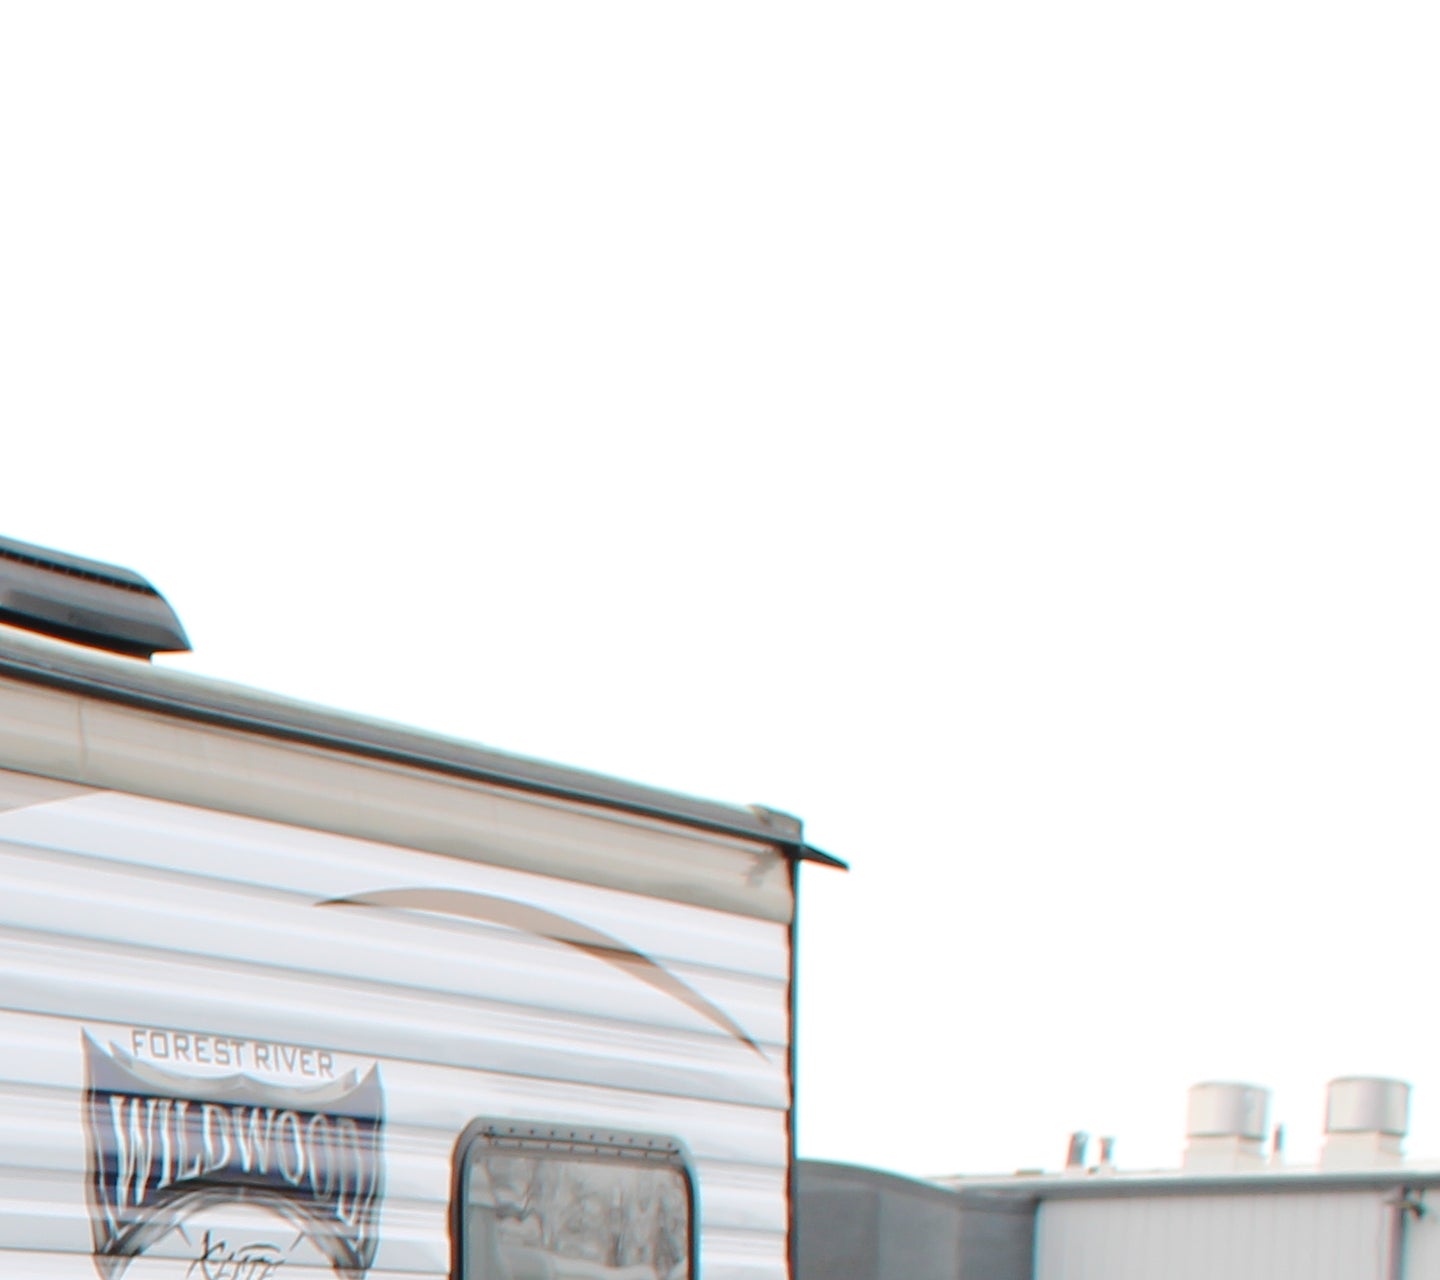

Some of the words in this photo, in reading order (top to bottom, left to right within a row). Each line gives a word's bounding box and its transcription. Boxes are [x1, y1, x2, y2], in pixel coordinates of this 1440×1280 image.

[131, 1029, 247, 1069] FOREST
[253, 1042, 336, 1079] RIVER
[110, 1095, 363, 1226] WILDWOOD
